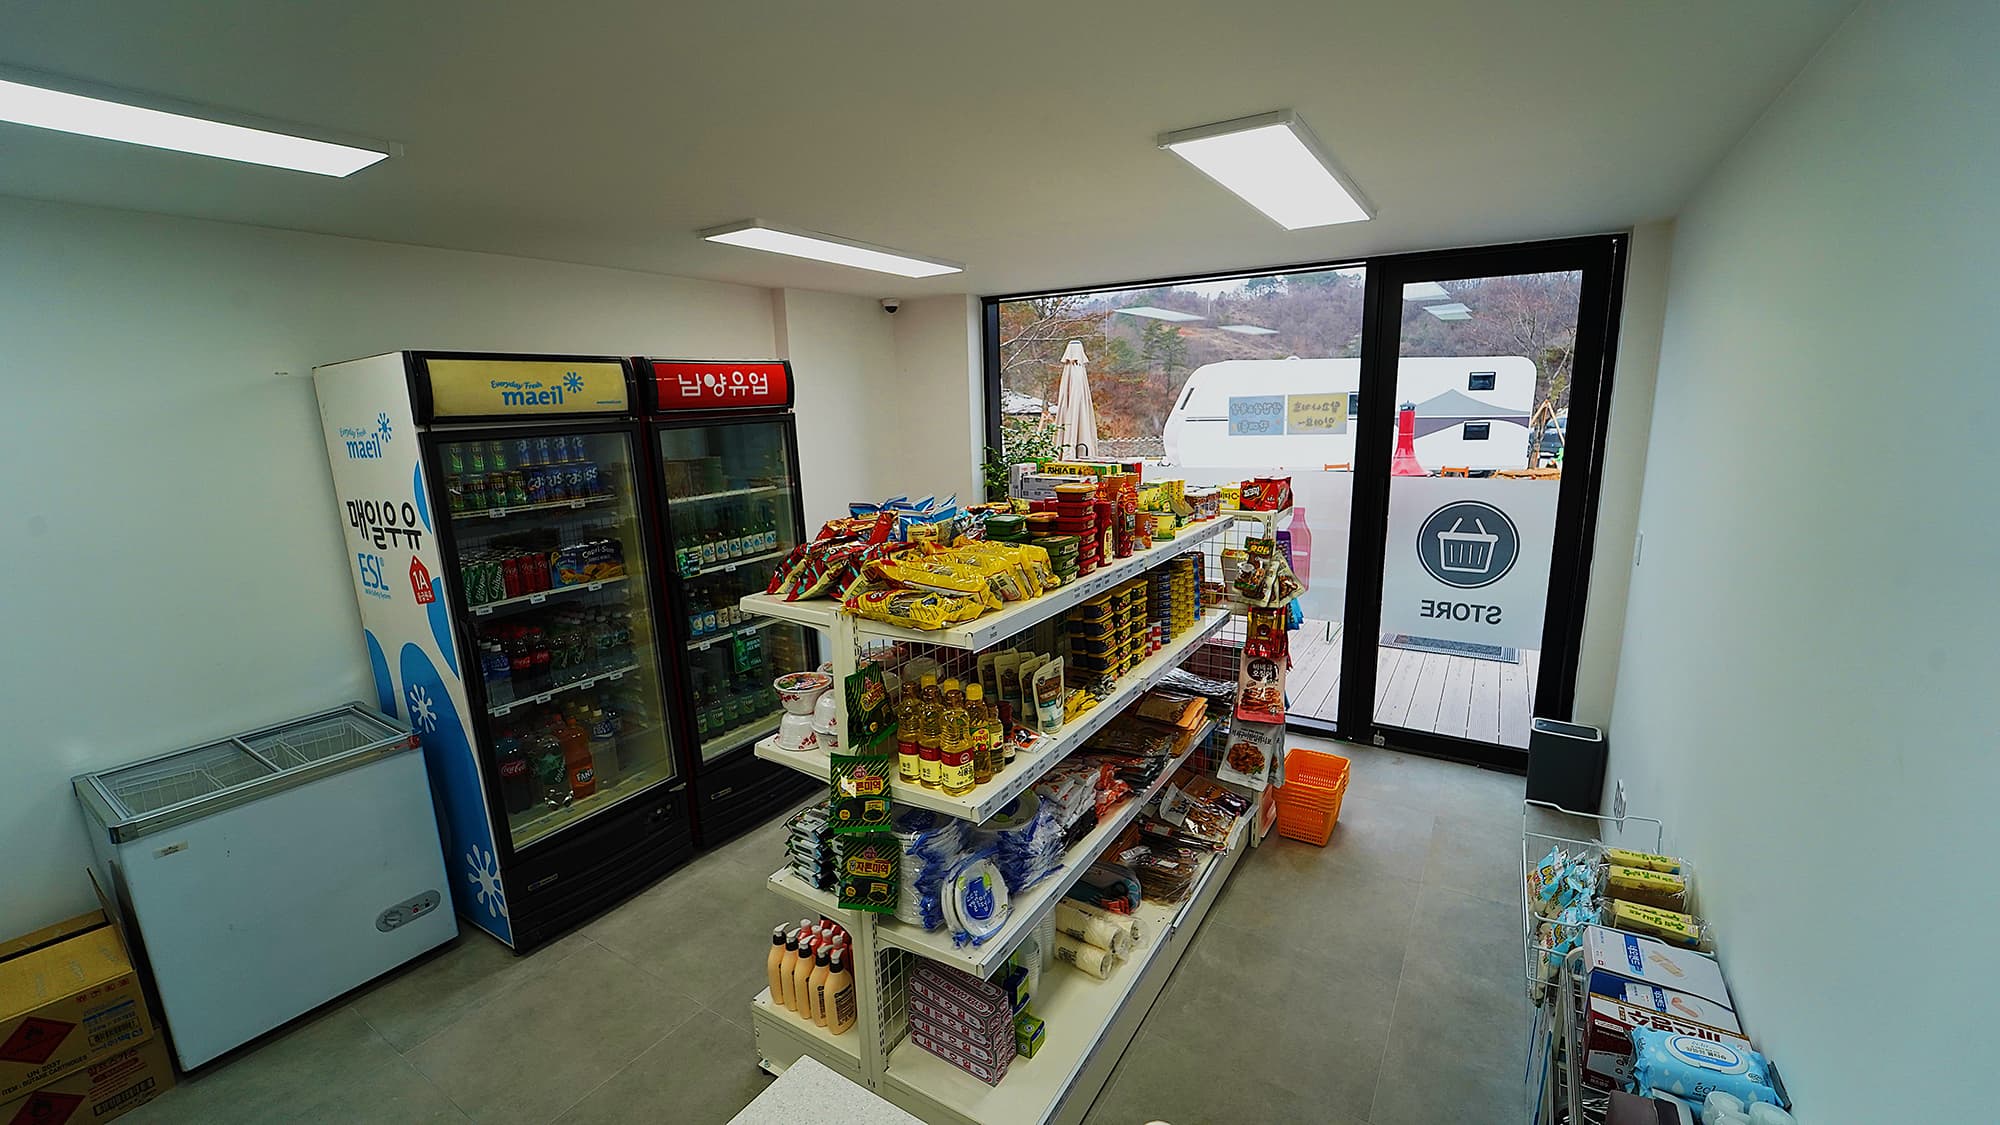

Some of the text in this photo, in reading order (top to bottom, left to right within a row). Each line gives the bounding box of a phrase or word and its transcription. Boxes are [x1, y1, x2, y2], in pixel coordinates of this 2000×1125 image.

[502, 385, 563, 406] maeil
[677, 370, 769, 397] 남양유업
[346, 432, 382, 458] maeil
[346, 499, 423, 551] 매일우유
[358, 552, 390, 592] ESL
[413, 569, 429, 591] 1A
[855, 861, 889, 874] 자른미역
